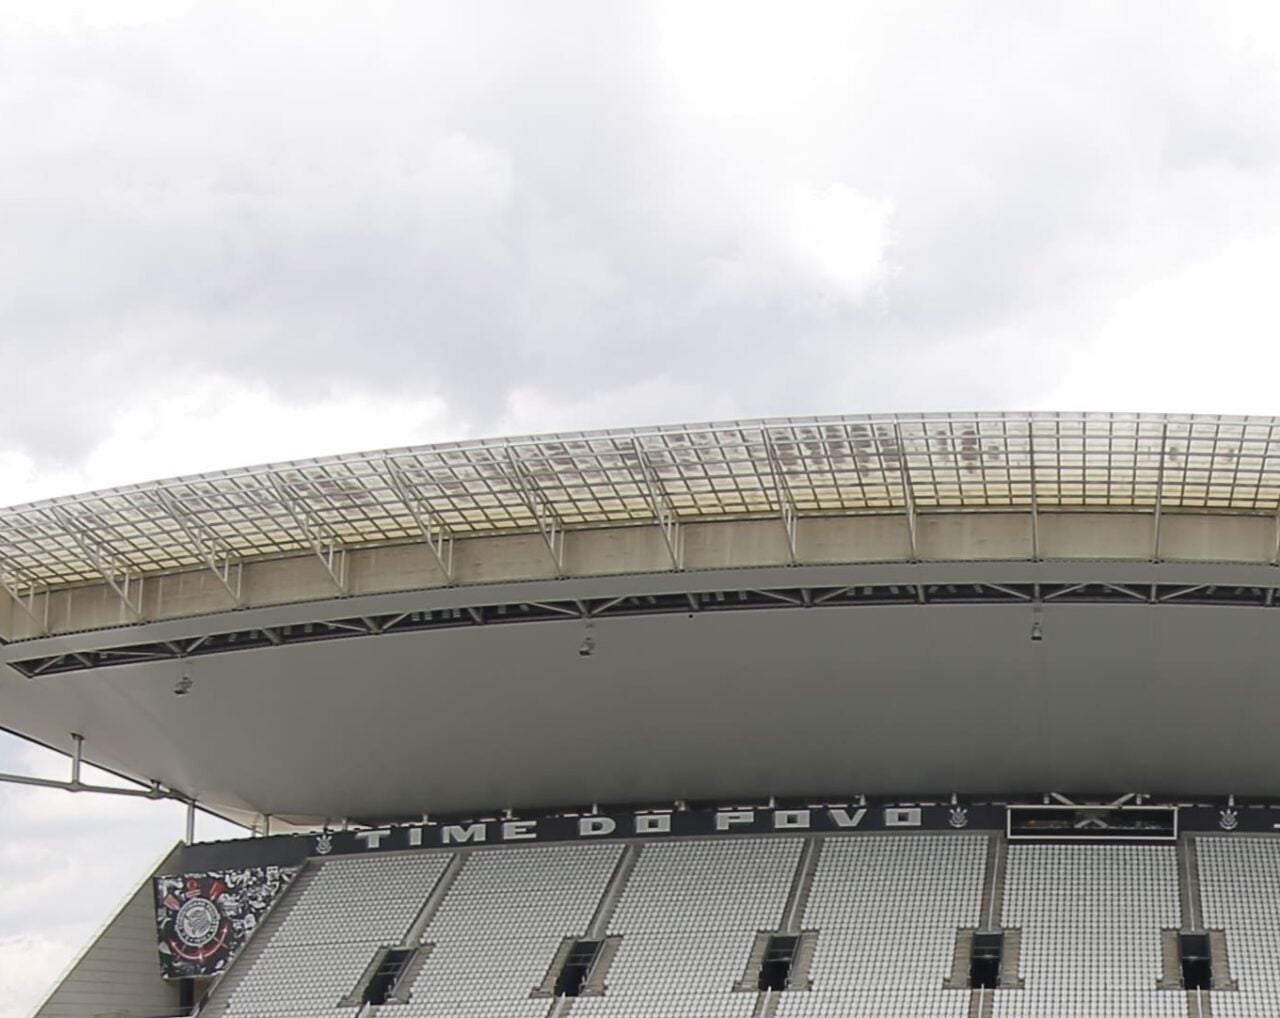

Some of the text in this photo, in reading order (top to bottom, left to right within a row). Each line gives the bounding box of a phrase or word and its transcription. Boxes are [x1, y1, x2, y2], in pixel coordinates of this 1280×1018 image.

[355, 807, 921, 849] TIME DO POVO
